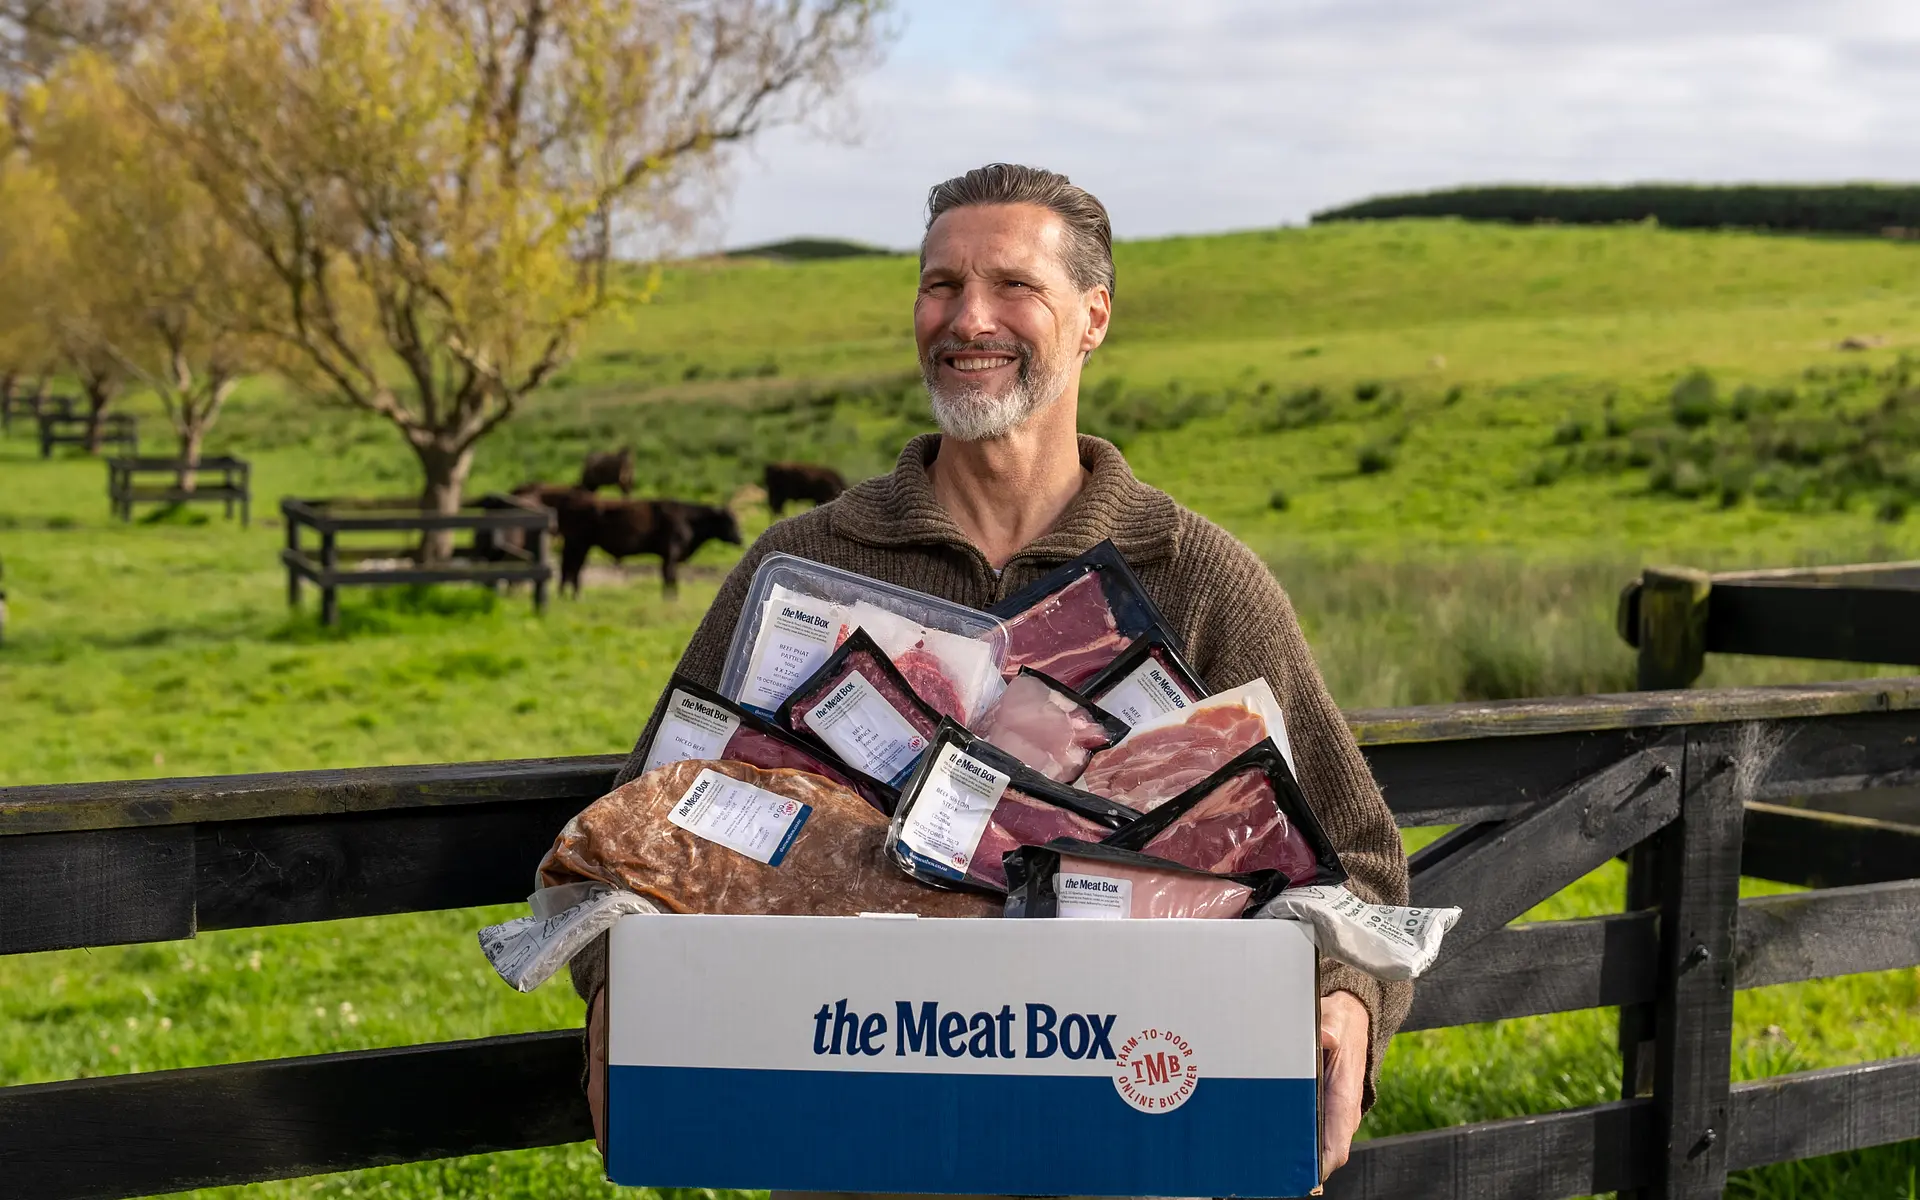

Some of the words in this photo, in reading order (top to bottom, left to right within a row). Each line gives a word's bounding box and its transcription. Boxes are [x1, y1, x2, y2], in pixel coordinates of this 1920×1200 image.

[782, 608, 795, 617] the
[794, 611, 815, 625] Meat
[814, 616, 830, 629] Box
[816, 708, 828, 719] the
[825, 694, 844, 712] Meat
[840, 682, 855, 696] Box
[1150, 670, 1162, 682] the
[1158, 679, 1176, 698] Meat
[1173, 695, 1186, 708] Box
[681, 698, 695, 709] the
[694, 702, 714, 717] Meat
[714, 710, 729, 723] Box
[961, 759, 982, 775] Meat
[980, 769, 996, 784] Box
[679, 805, 690, 816] the
[686, 791, 701, 809] Meat
[696, 780, 710, 794] Box
[1065, 878, 1078, 888] the
[1080, 880, 1101, 890] Meat
[1102, 882, 1119, 892] Box
[813, 998, 887, 1056] the
[895, 1001, 1016, 1058] Meat
[1025, 1003, 1117, 1060] Box
[1117, 1029, 1192, 1067] FARM-TO-DOOR
[1119, 1076, 1154, 1108] ONLINE
[1160, 1065, 1197, 1108] BUTCHER
[1131, 1052, 1182, 1085] TMB
